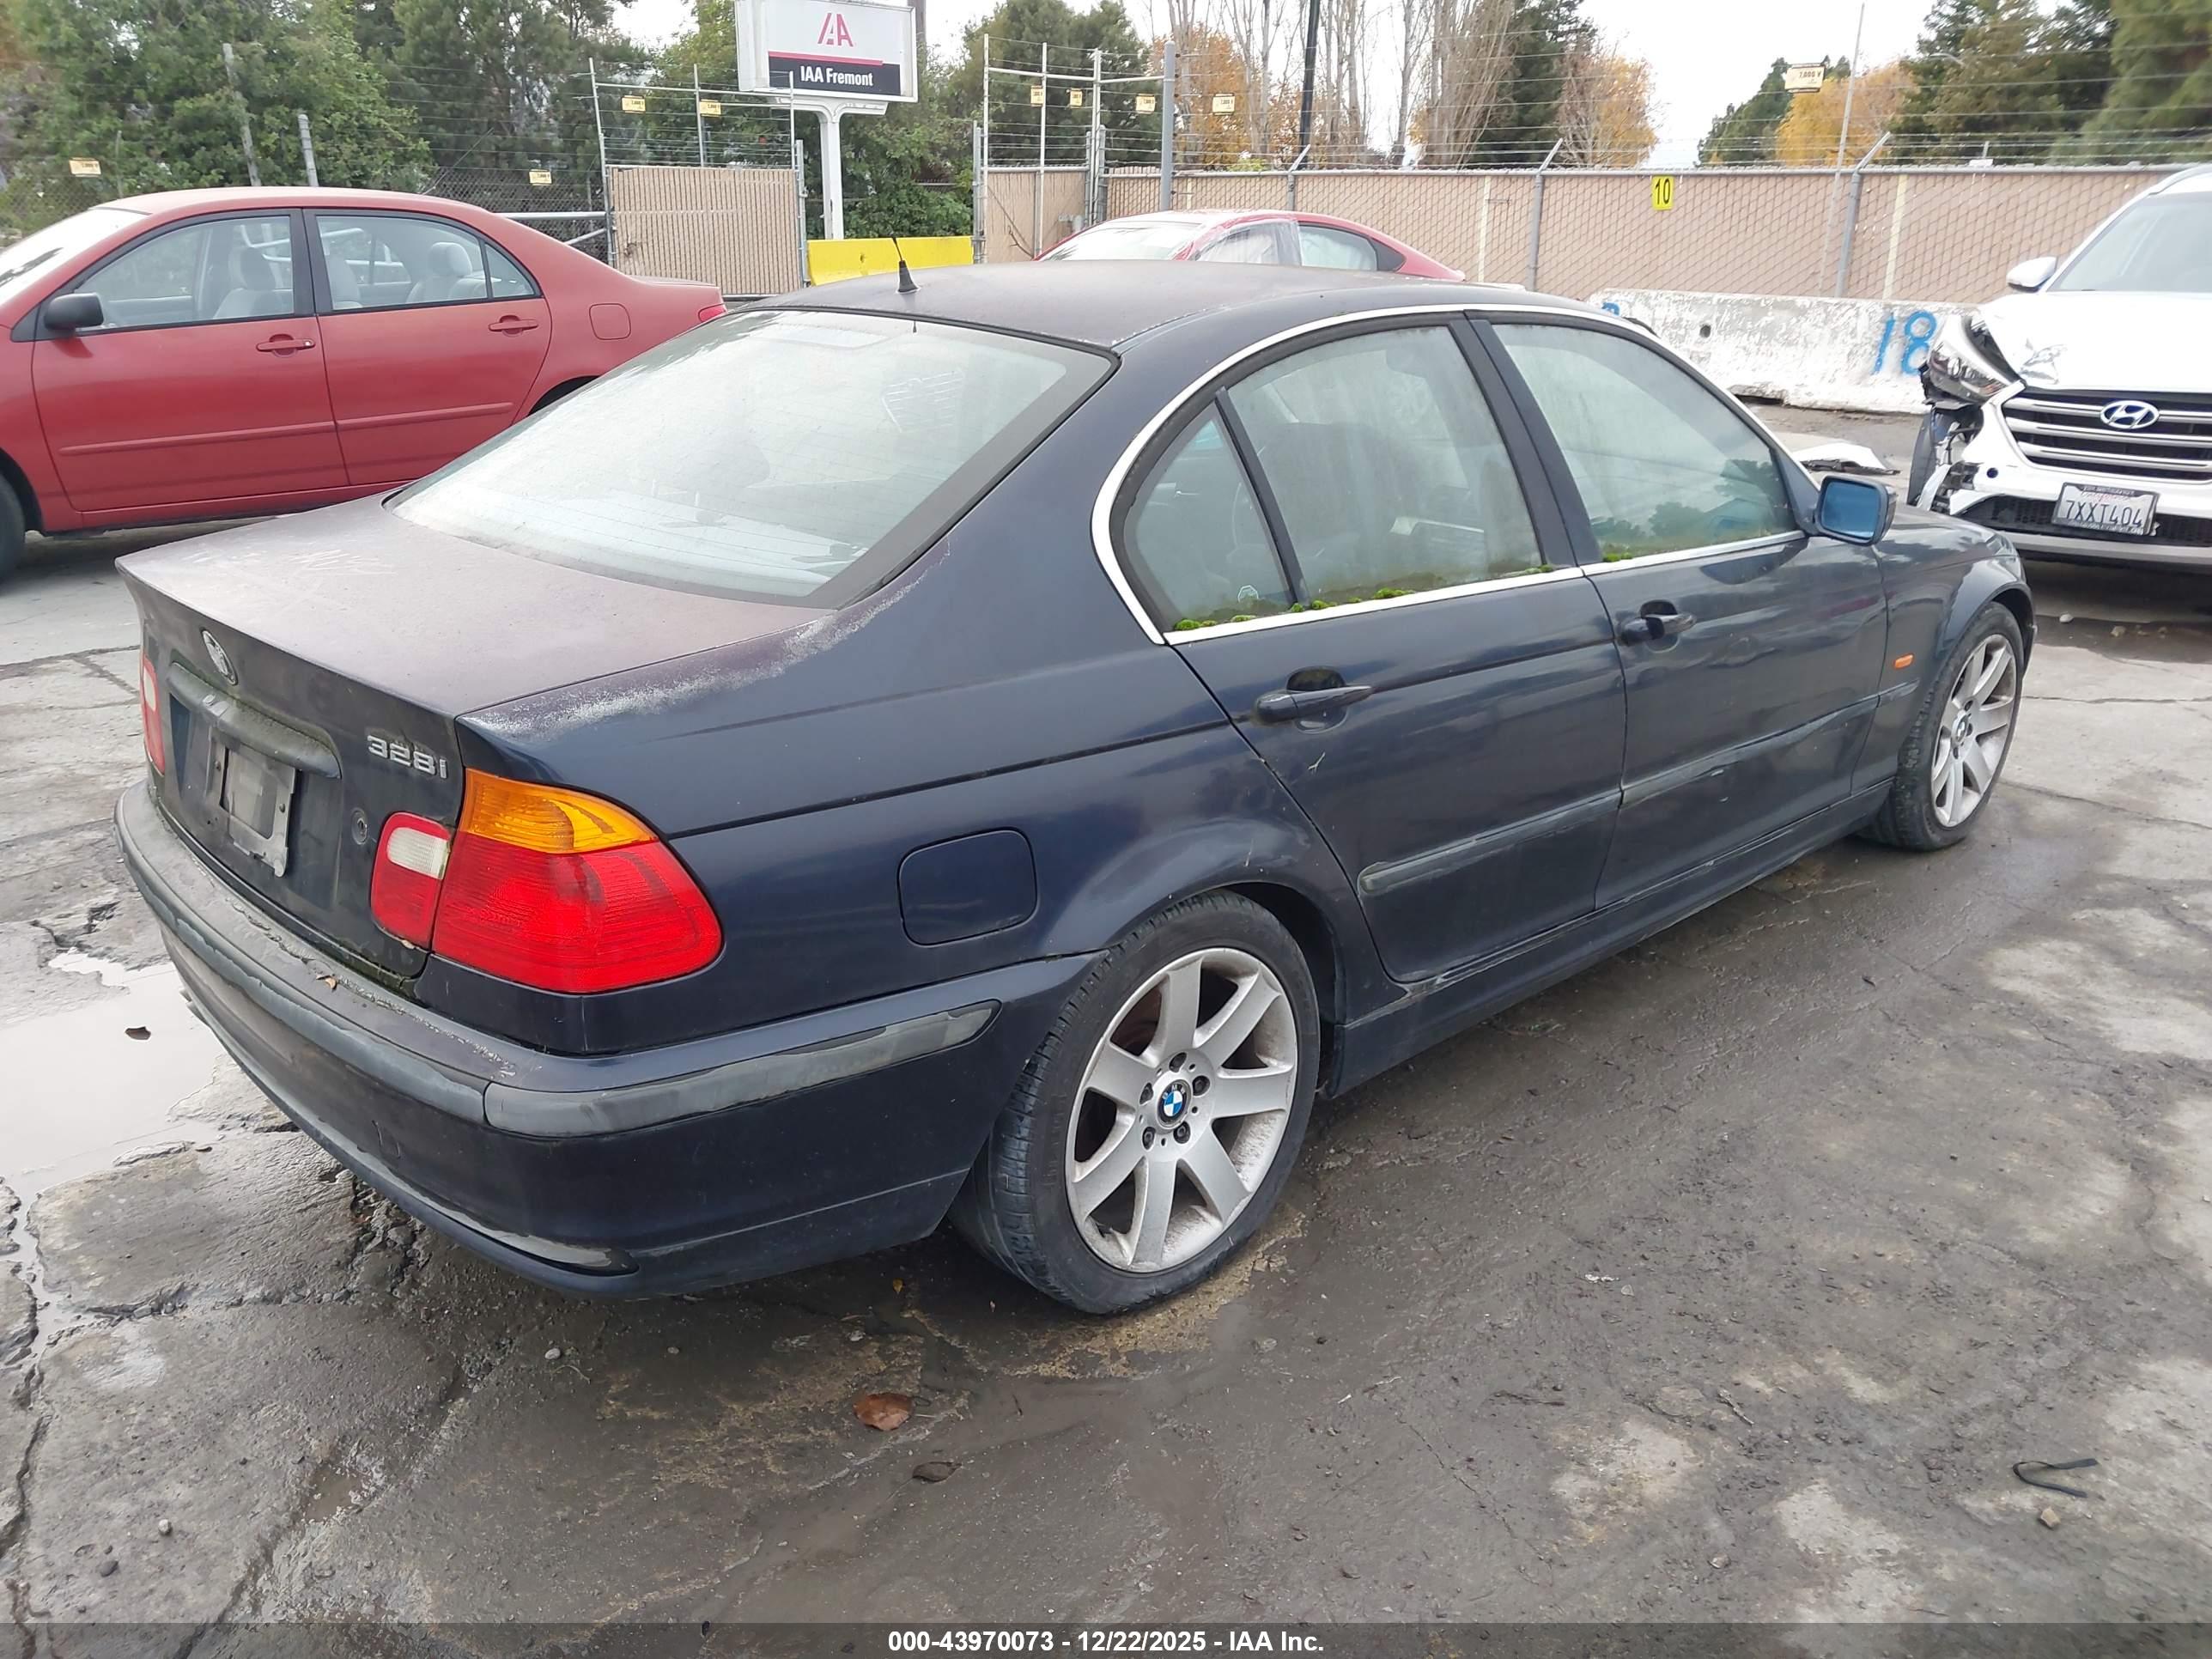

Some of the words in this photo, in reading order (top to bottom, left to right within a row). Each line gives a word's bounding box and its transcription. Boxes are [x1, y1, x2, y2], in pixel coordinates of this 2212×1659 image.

[800, 66, 823, 82] IAA
[826, 68, 873, 87] Fremont
[1655, 178, 1671, 205] 10
[1870, 310, 1936, 375] 18
[2066, 500, 2142, 529] 7XXT404
[367, 735, 447, 779] 328i
